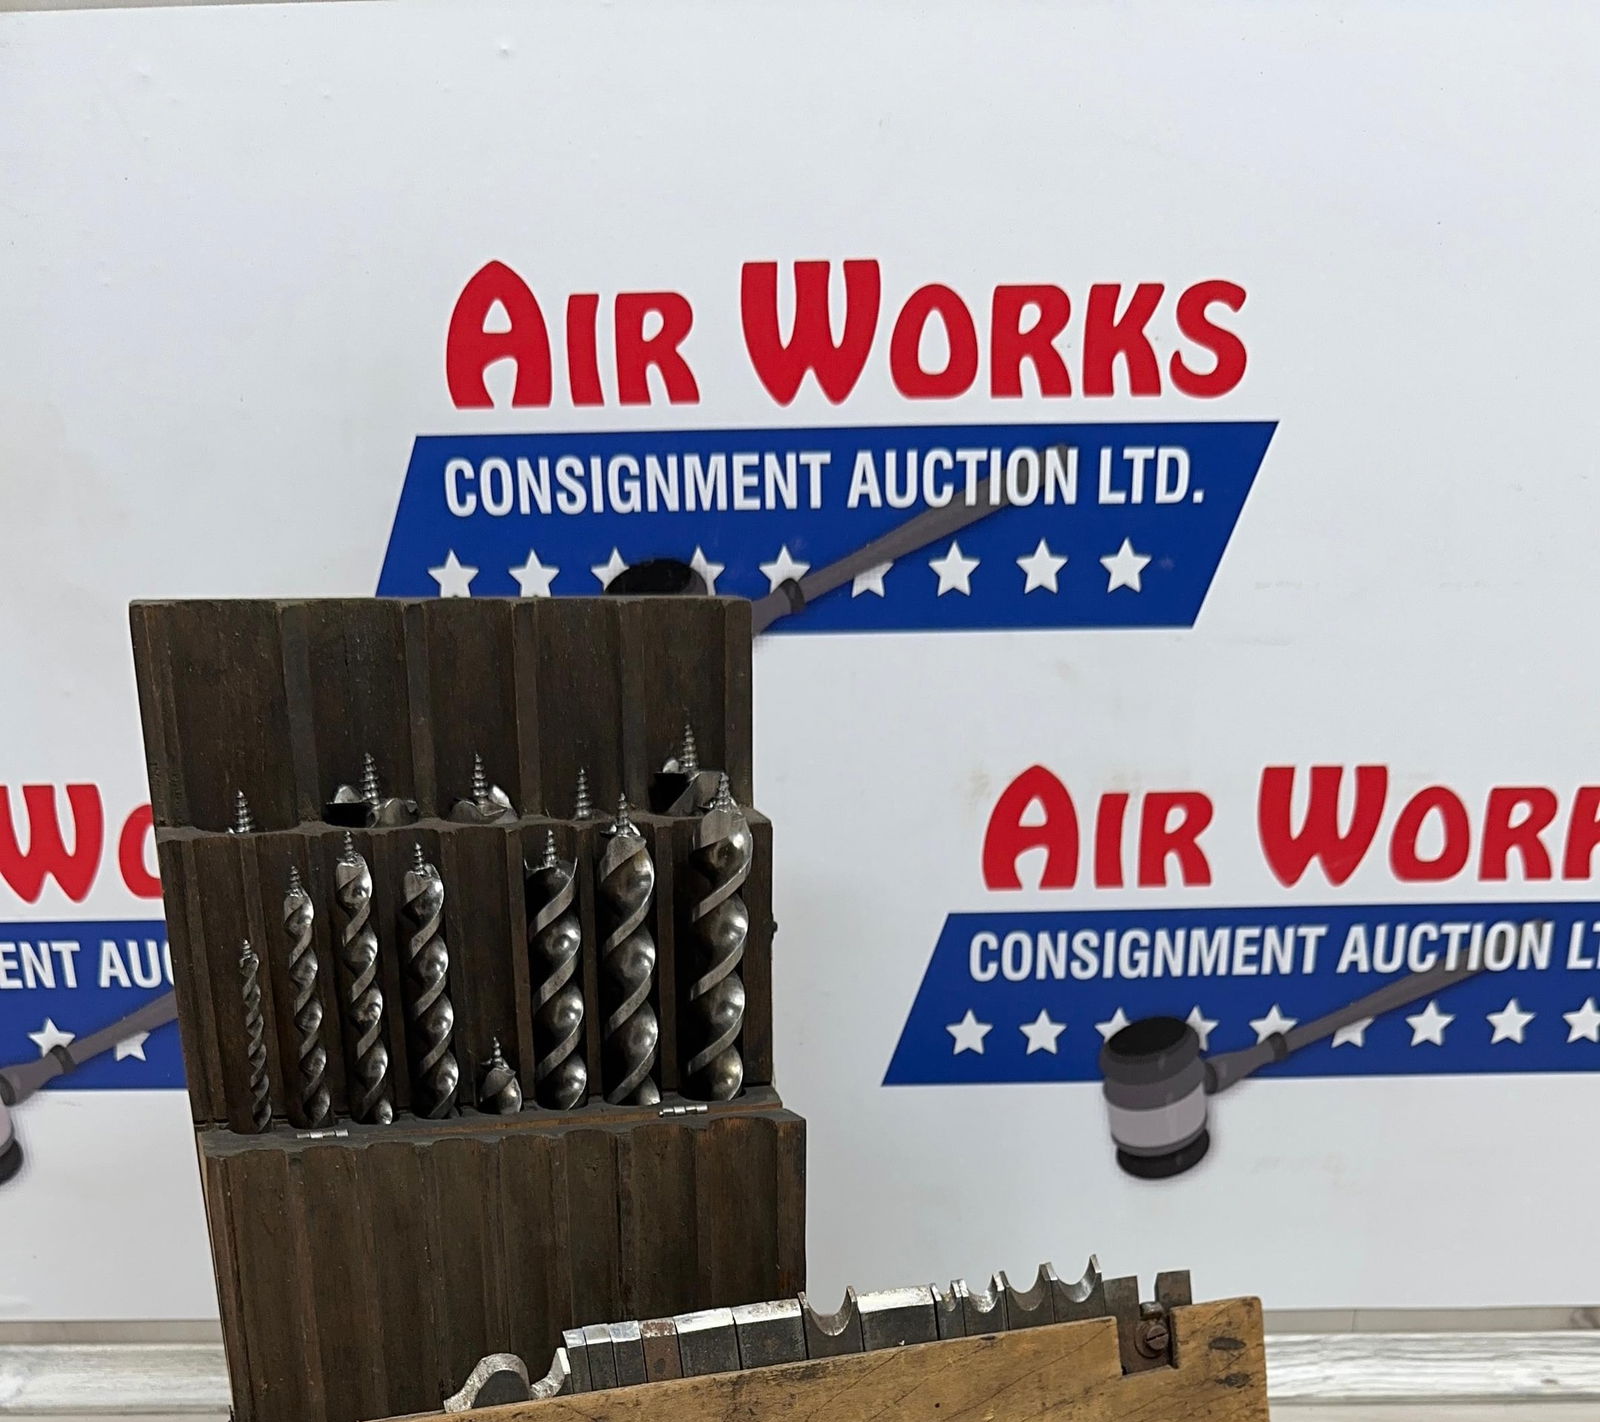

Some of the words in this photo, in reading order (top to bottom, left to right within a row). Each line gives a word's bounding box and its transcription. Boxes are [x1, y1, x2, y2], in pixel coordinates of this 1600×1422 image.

[445, 259, 700, 409] AIR
[740, 258, 1248, 406] WORKS
[443, 452, 831, 517] CONSIGNMENT
[847, 447, 1078, 508] AUCTION
[1098, 447, 1204, 504] LTD.
[981, 764, 1214, 891] AIR
[969, 926, 1328, 982] CONSIGNMENT
[1336, 922, 1554, 973] AUCTION
[1566, 921, 1600, 970] L
